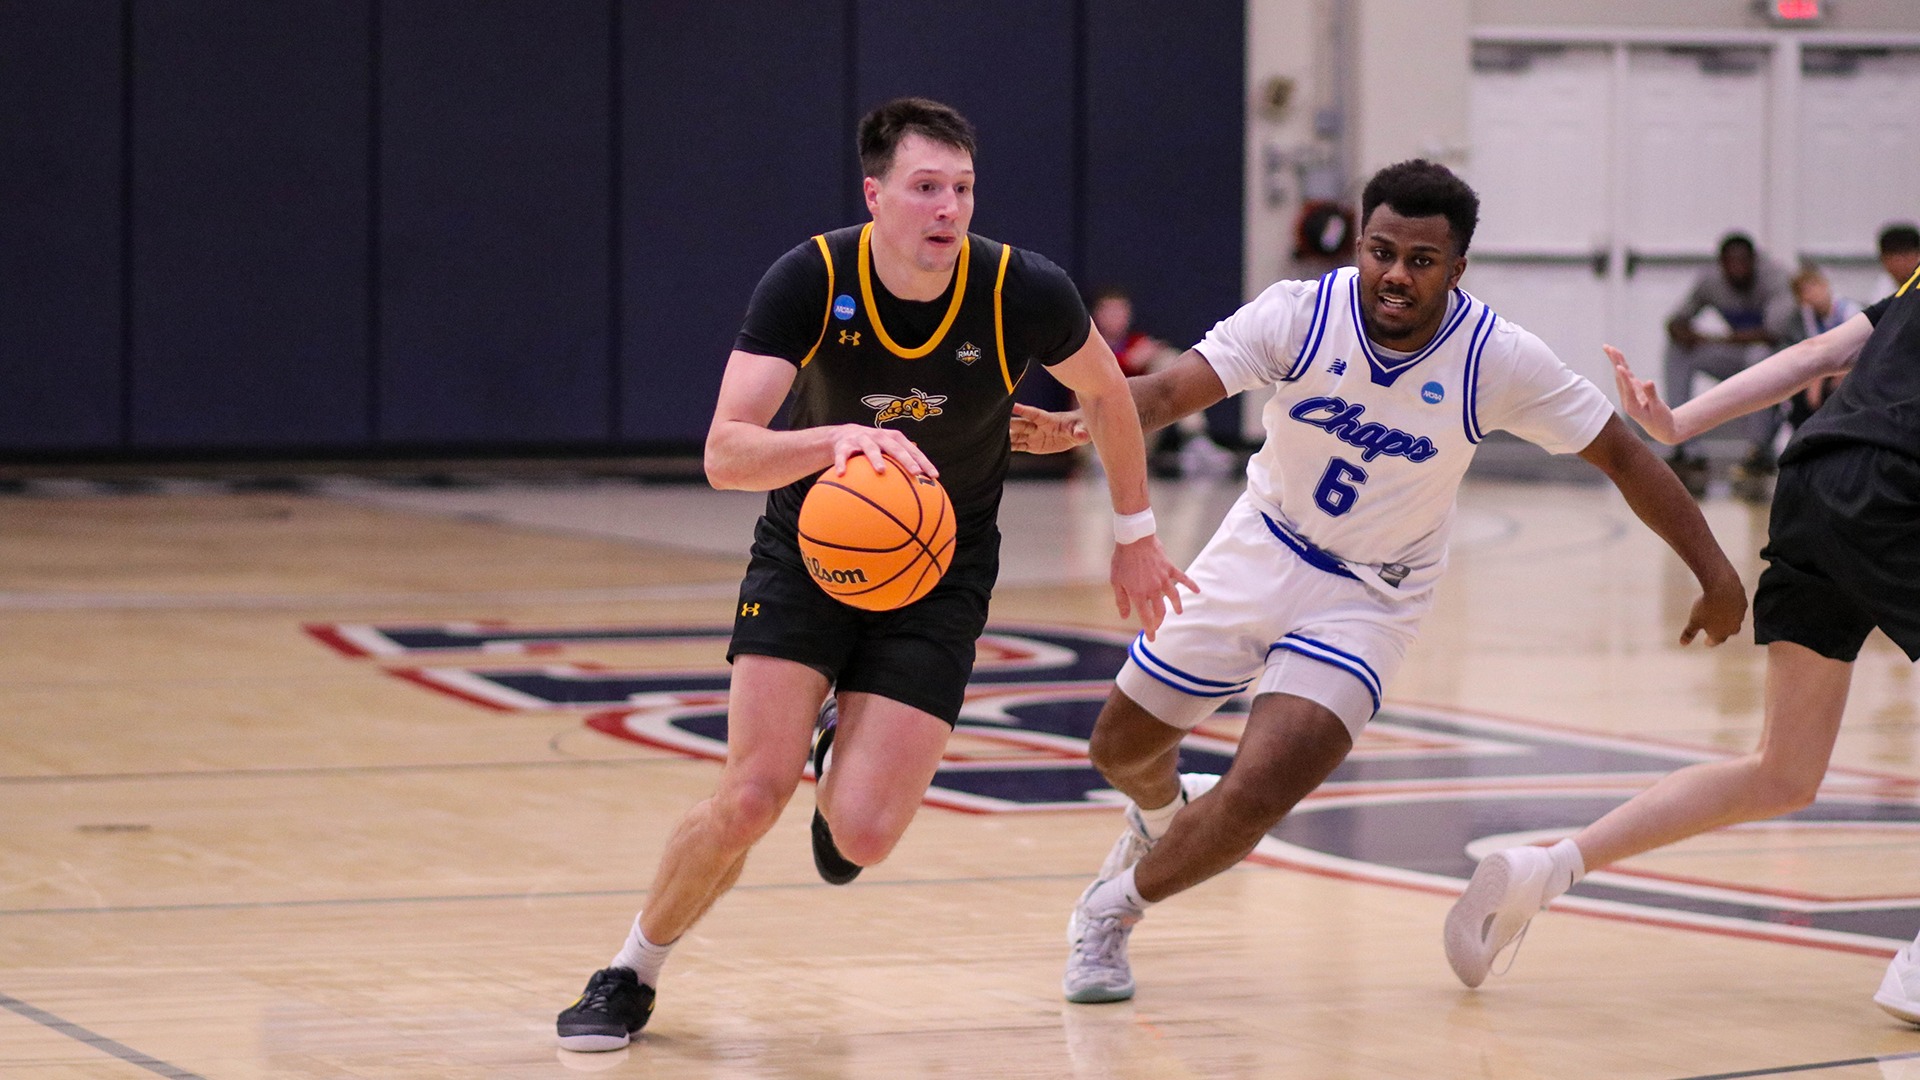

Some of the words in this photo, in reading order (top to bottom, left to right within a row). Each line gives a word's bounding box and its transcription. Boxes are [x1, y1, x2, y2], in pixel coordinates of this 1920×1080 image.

[835, 304, 855, 315] NCAA
[958, 349, 980, 358] RMAC
[1422, 389, 1443, 401] NCAA
[1289, 396, 1439, 464] Chaps
[1312, 455, 1369, 518] 6
[802, 554, 868, 585] ilson
